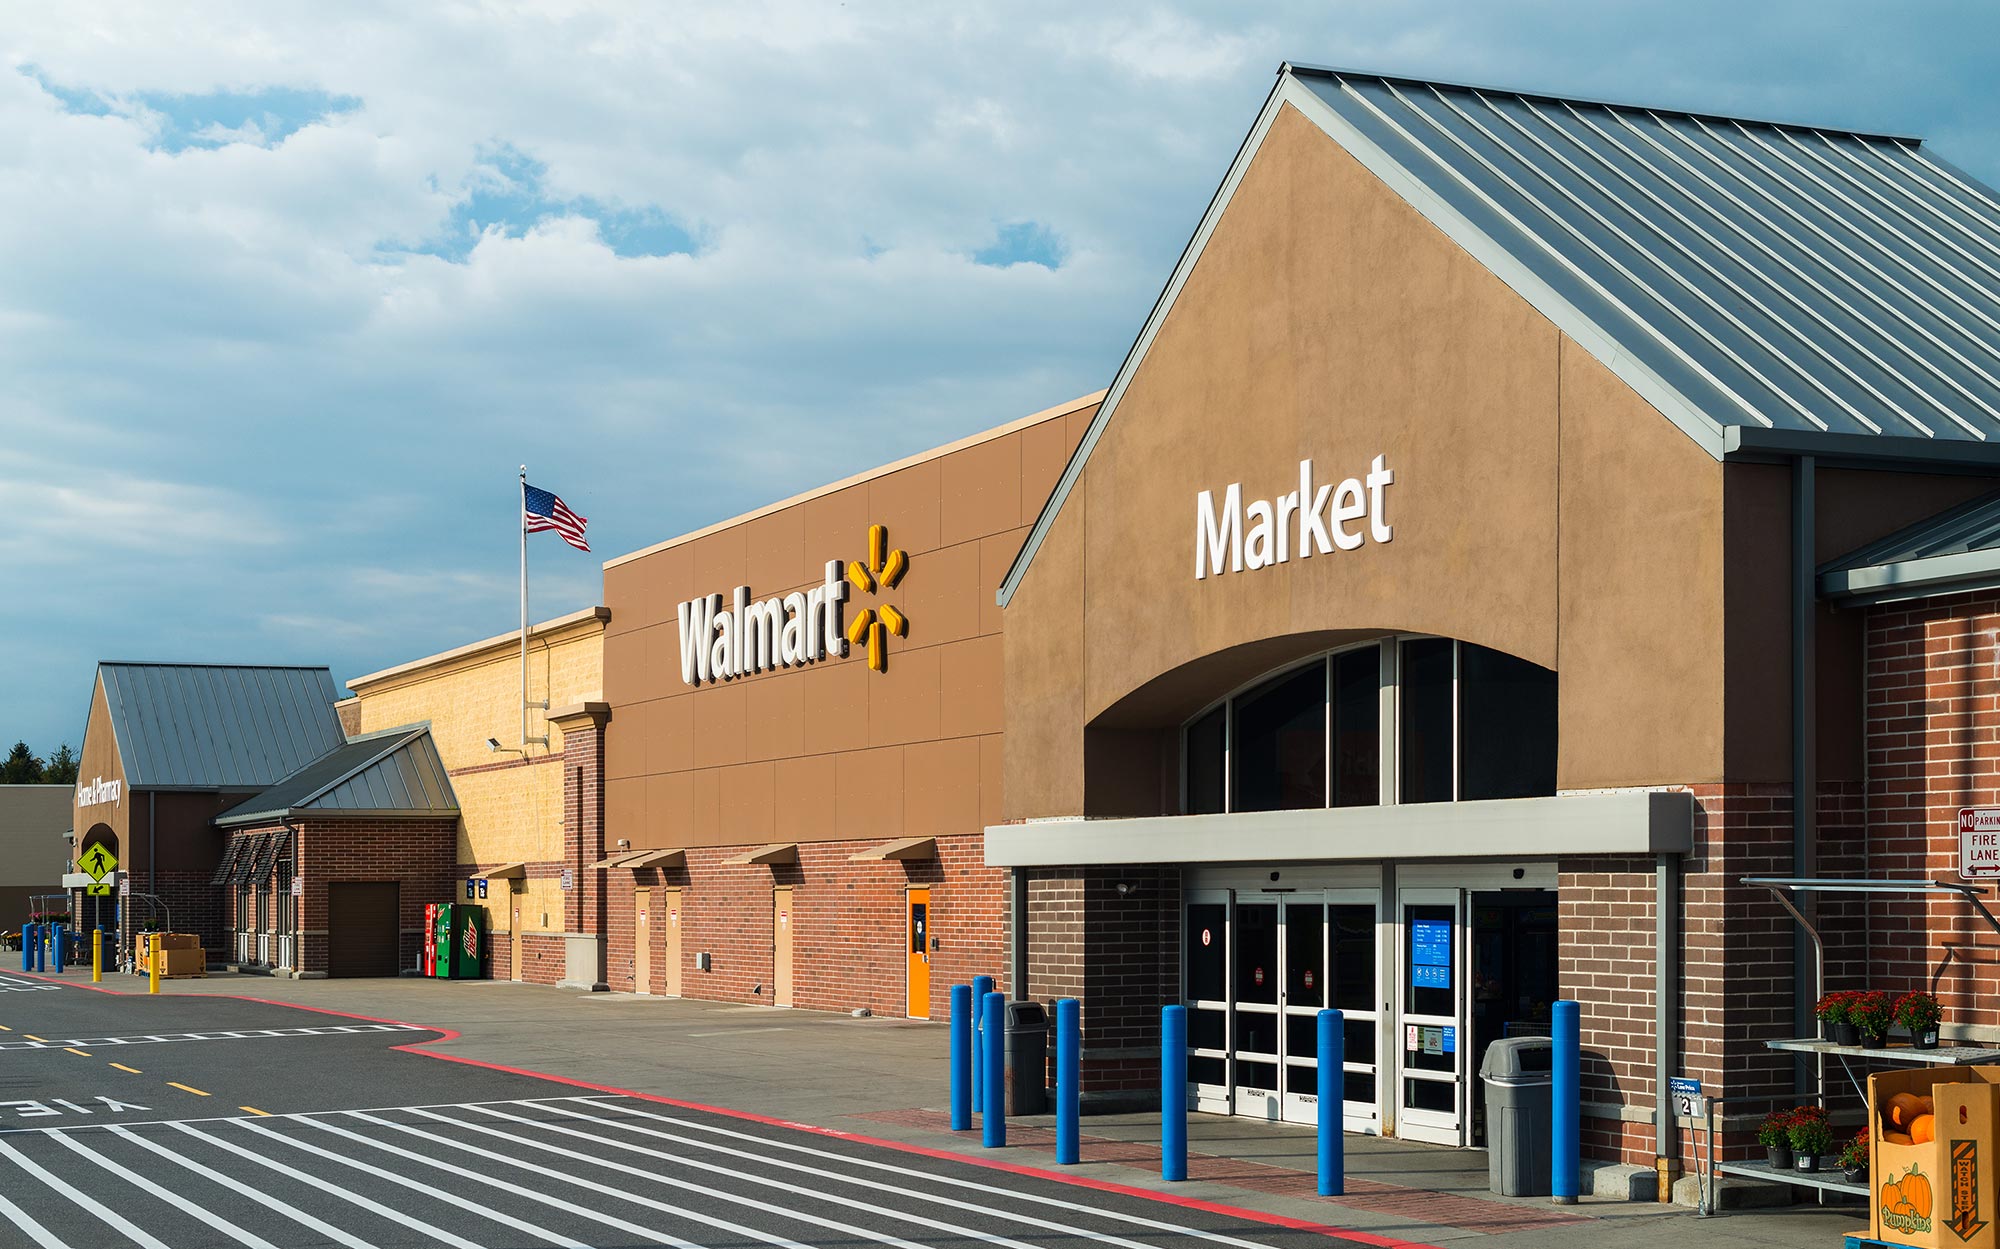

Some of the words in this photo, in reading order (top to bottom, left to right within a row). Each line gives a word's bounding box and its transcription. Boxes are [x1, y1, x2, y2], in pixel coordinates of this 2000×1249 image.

[1196, 454, 1394, 580] Market
[678, 560, 848, 687] Walmart
[78, 781, 92, 808] Home
[97, 776, 121, 808] Pharmacy
[1961, 814, 1974, 828] NO
[1975, 816, 2000, 826] PARKIN
[1972, 834, 1997, 846] FIRE
[1970, 849, 1999, 861] LANE
[0, 1096, 152, 1118] YIE
[1682, 1098, 1690, 1113] 2
[1958, 1161, 1970, 1187] WATCH
[1960, 1190, 1969, 1210] STEP
[1881, 1205, 1931, 1233] Pumpkins
